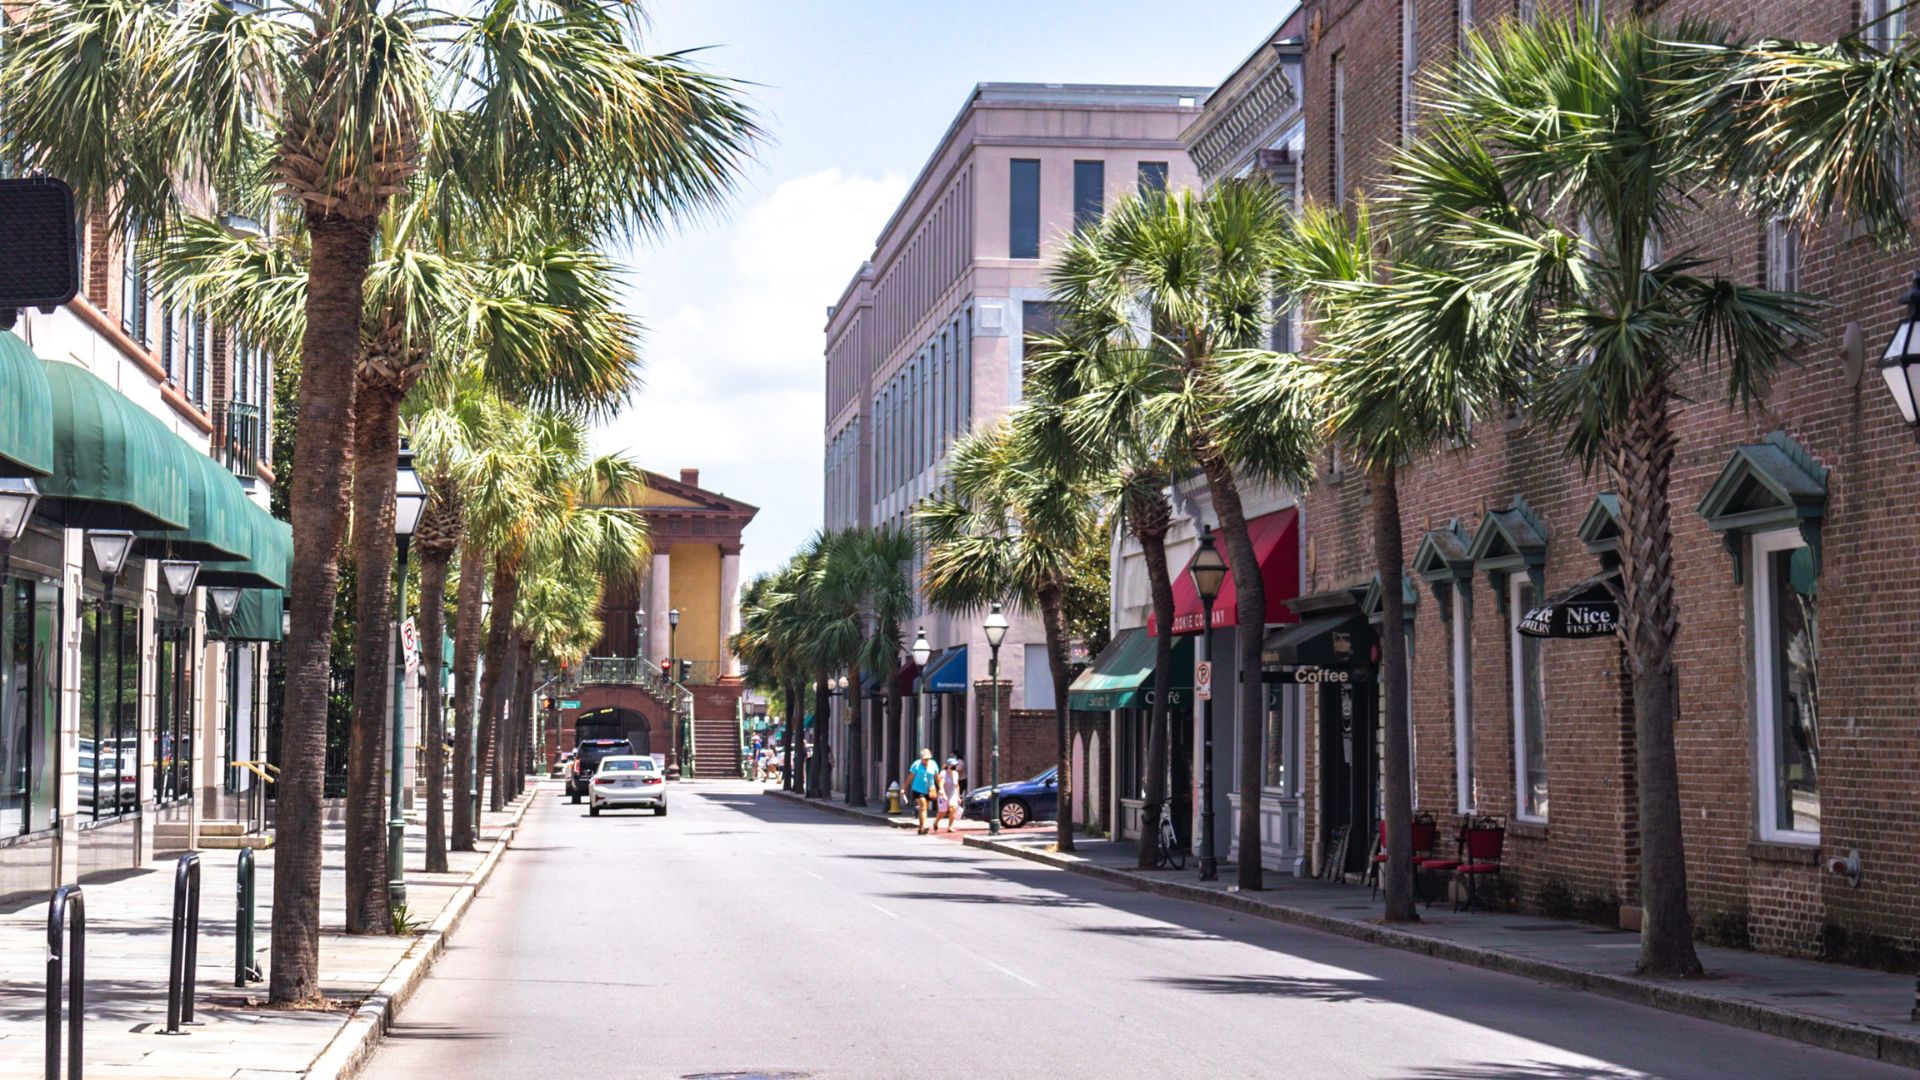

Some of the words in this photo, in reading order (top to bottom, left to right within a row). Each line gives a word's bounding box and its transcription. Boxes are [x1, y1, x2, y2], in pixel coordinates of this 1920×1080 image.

[1194, 609, 1225, 627] COANY
[1566, 607, 1611, 625] Nice
[1566, 624, 1593, 634] FINE
[1295, 668, 1348, 683] Coffee
[1145, 691, 1180, 704] Cfé
